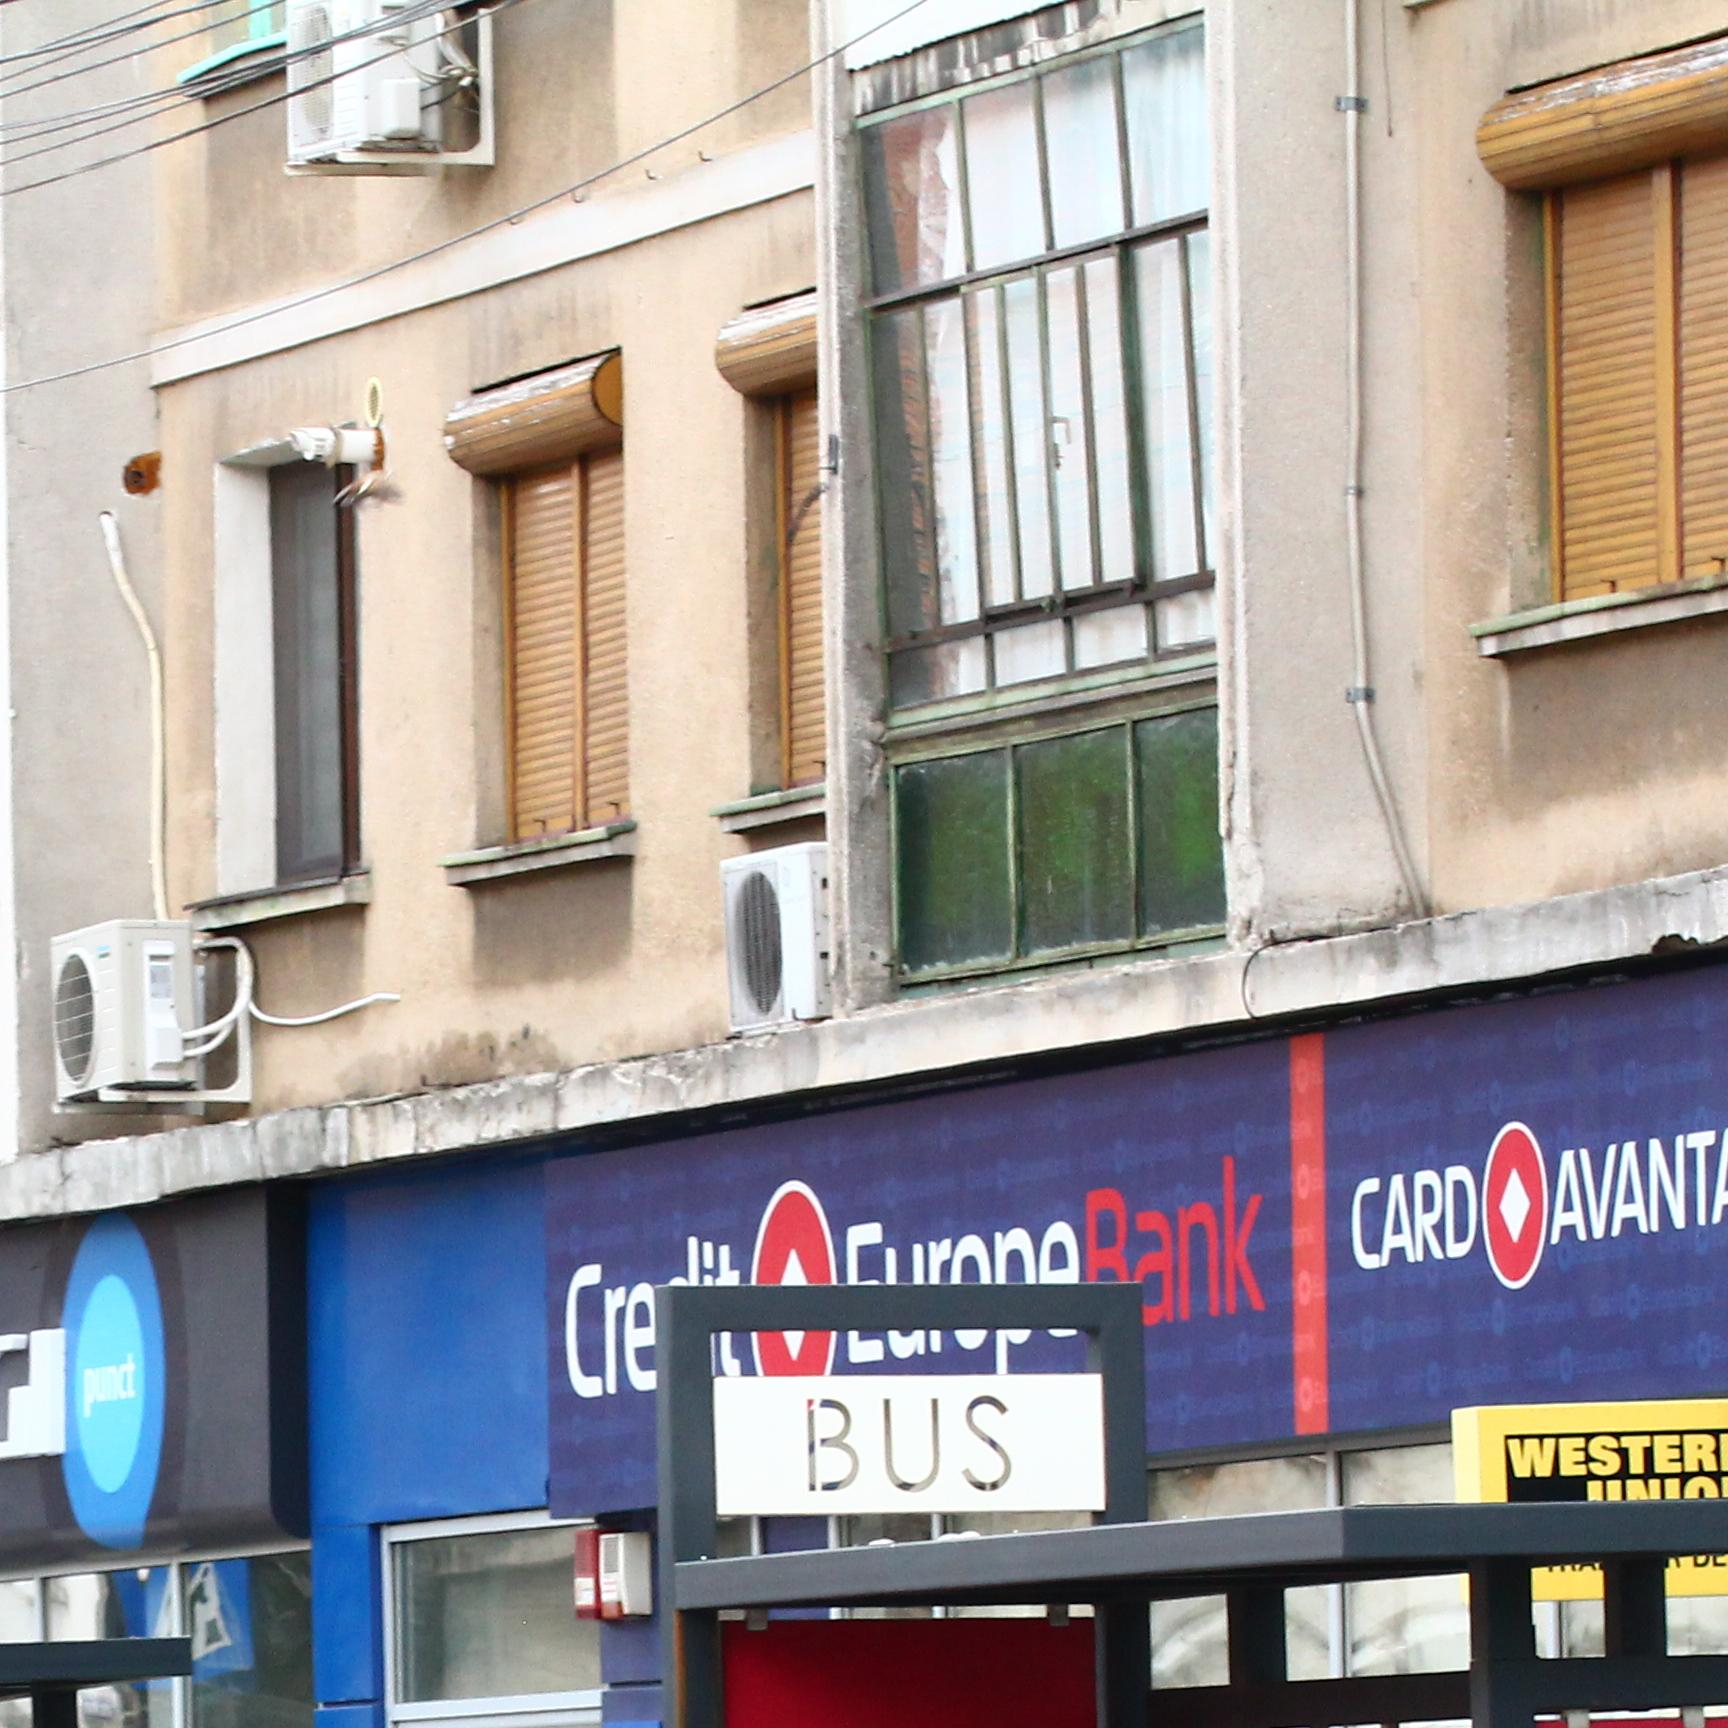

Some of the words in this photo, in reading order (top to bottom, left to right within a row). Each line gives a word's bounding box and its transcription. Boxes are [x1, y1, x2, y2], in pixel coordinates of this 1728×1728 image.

[1351, 1165, 1477, 1270] CARD
[565, 1235, 741, 1399] Cret
[83, 1351, 136, 1418] punct
[807, 1395, 1013, 1493] BUS
